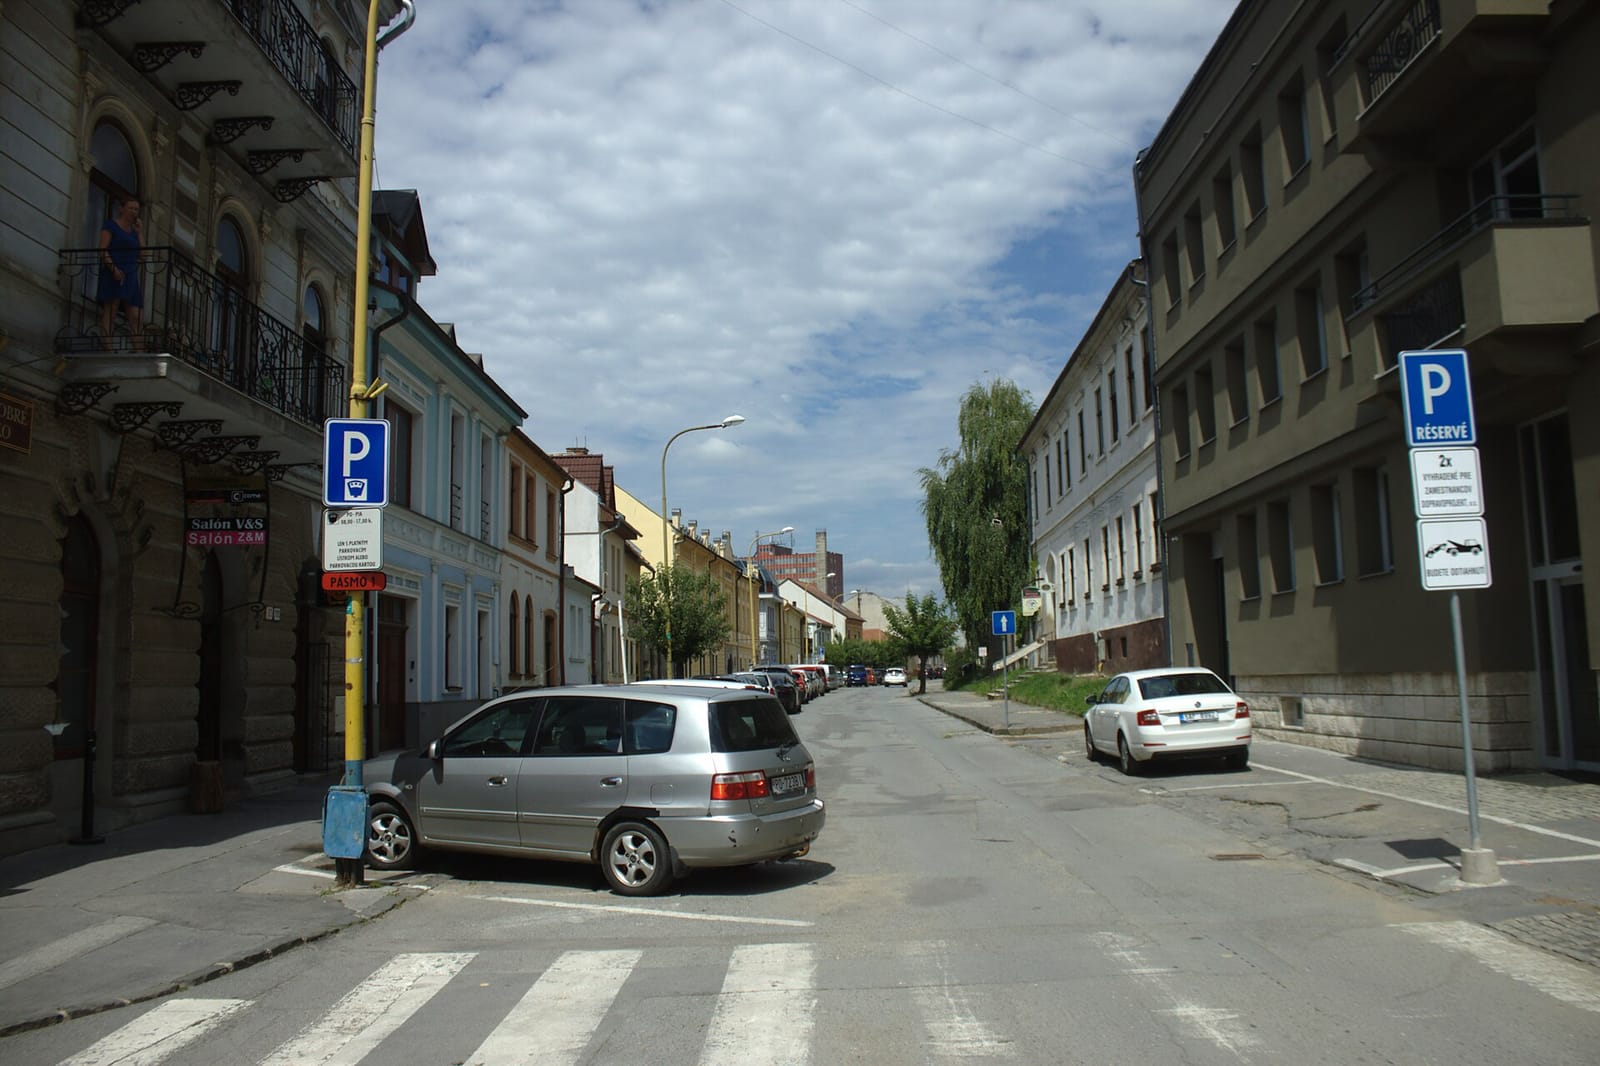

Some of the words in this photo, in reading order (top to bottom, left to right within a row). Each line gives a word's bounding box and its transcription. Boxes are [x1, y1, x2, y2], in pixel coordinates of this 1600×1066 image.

[1420, 363, 1452, 415] P
[1416, 421, 1469, 441] RÉSERVÉ
[342, 431, 370, 477] P
[1438, 454, 1453, 468] 2x
[191, 518, 231, 529] Salón
[235, 518, 264, 529] V&S
[188, 532, 232, 545] Salón
[237, 532, 264, 542] Z&M
